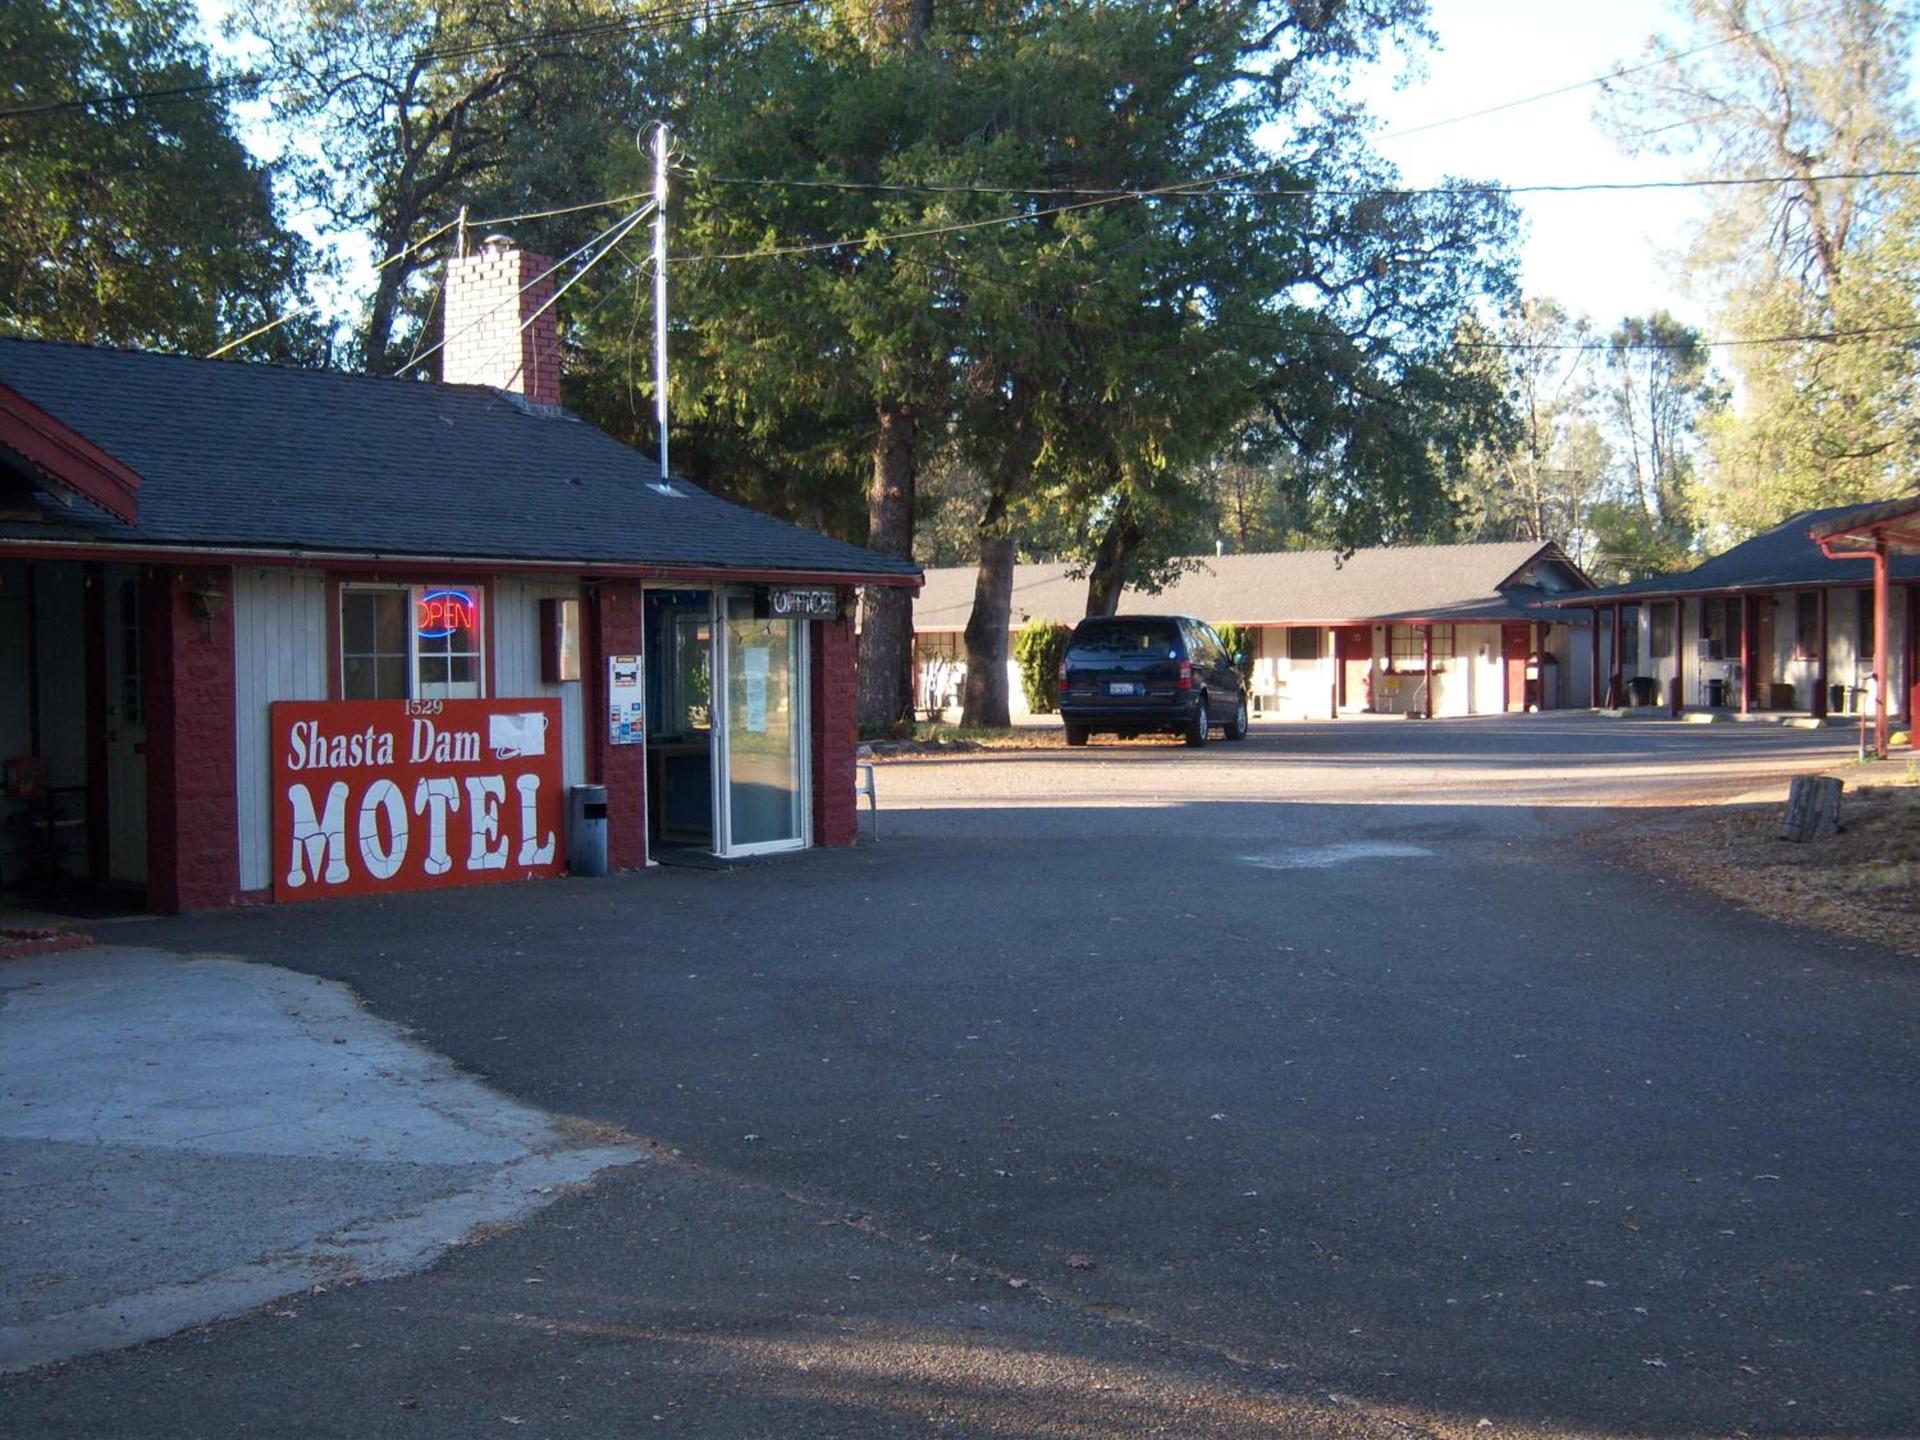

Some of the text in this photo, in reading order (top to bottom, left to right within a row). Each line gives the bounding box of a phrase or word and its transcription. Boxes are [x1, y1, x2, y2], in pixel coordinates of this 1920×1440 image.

[416, 601, 473, 630] OPEN
[773, 591, 832, 614] OFFICE
[404, 699, 443, 715] 1529
[288, 718, 480, 770] Shasta Dam
[287, 773, 555, 888] MOTEL
